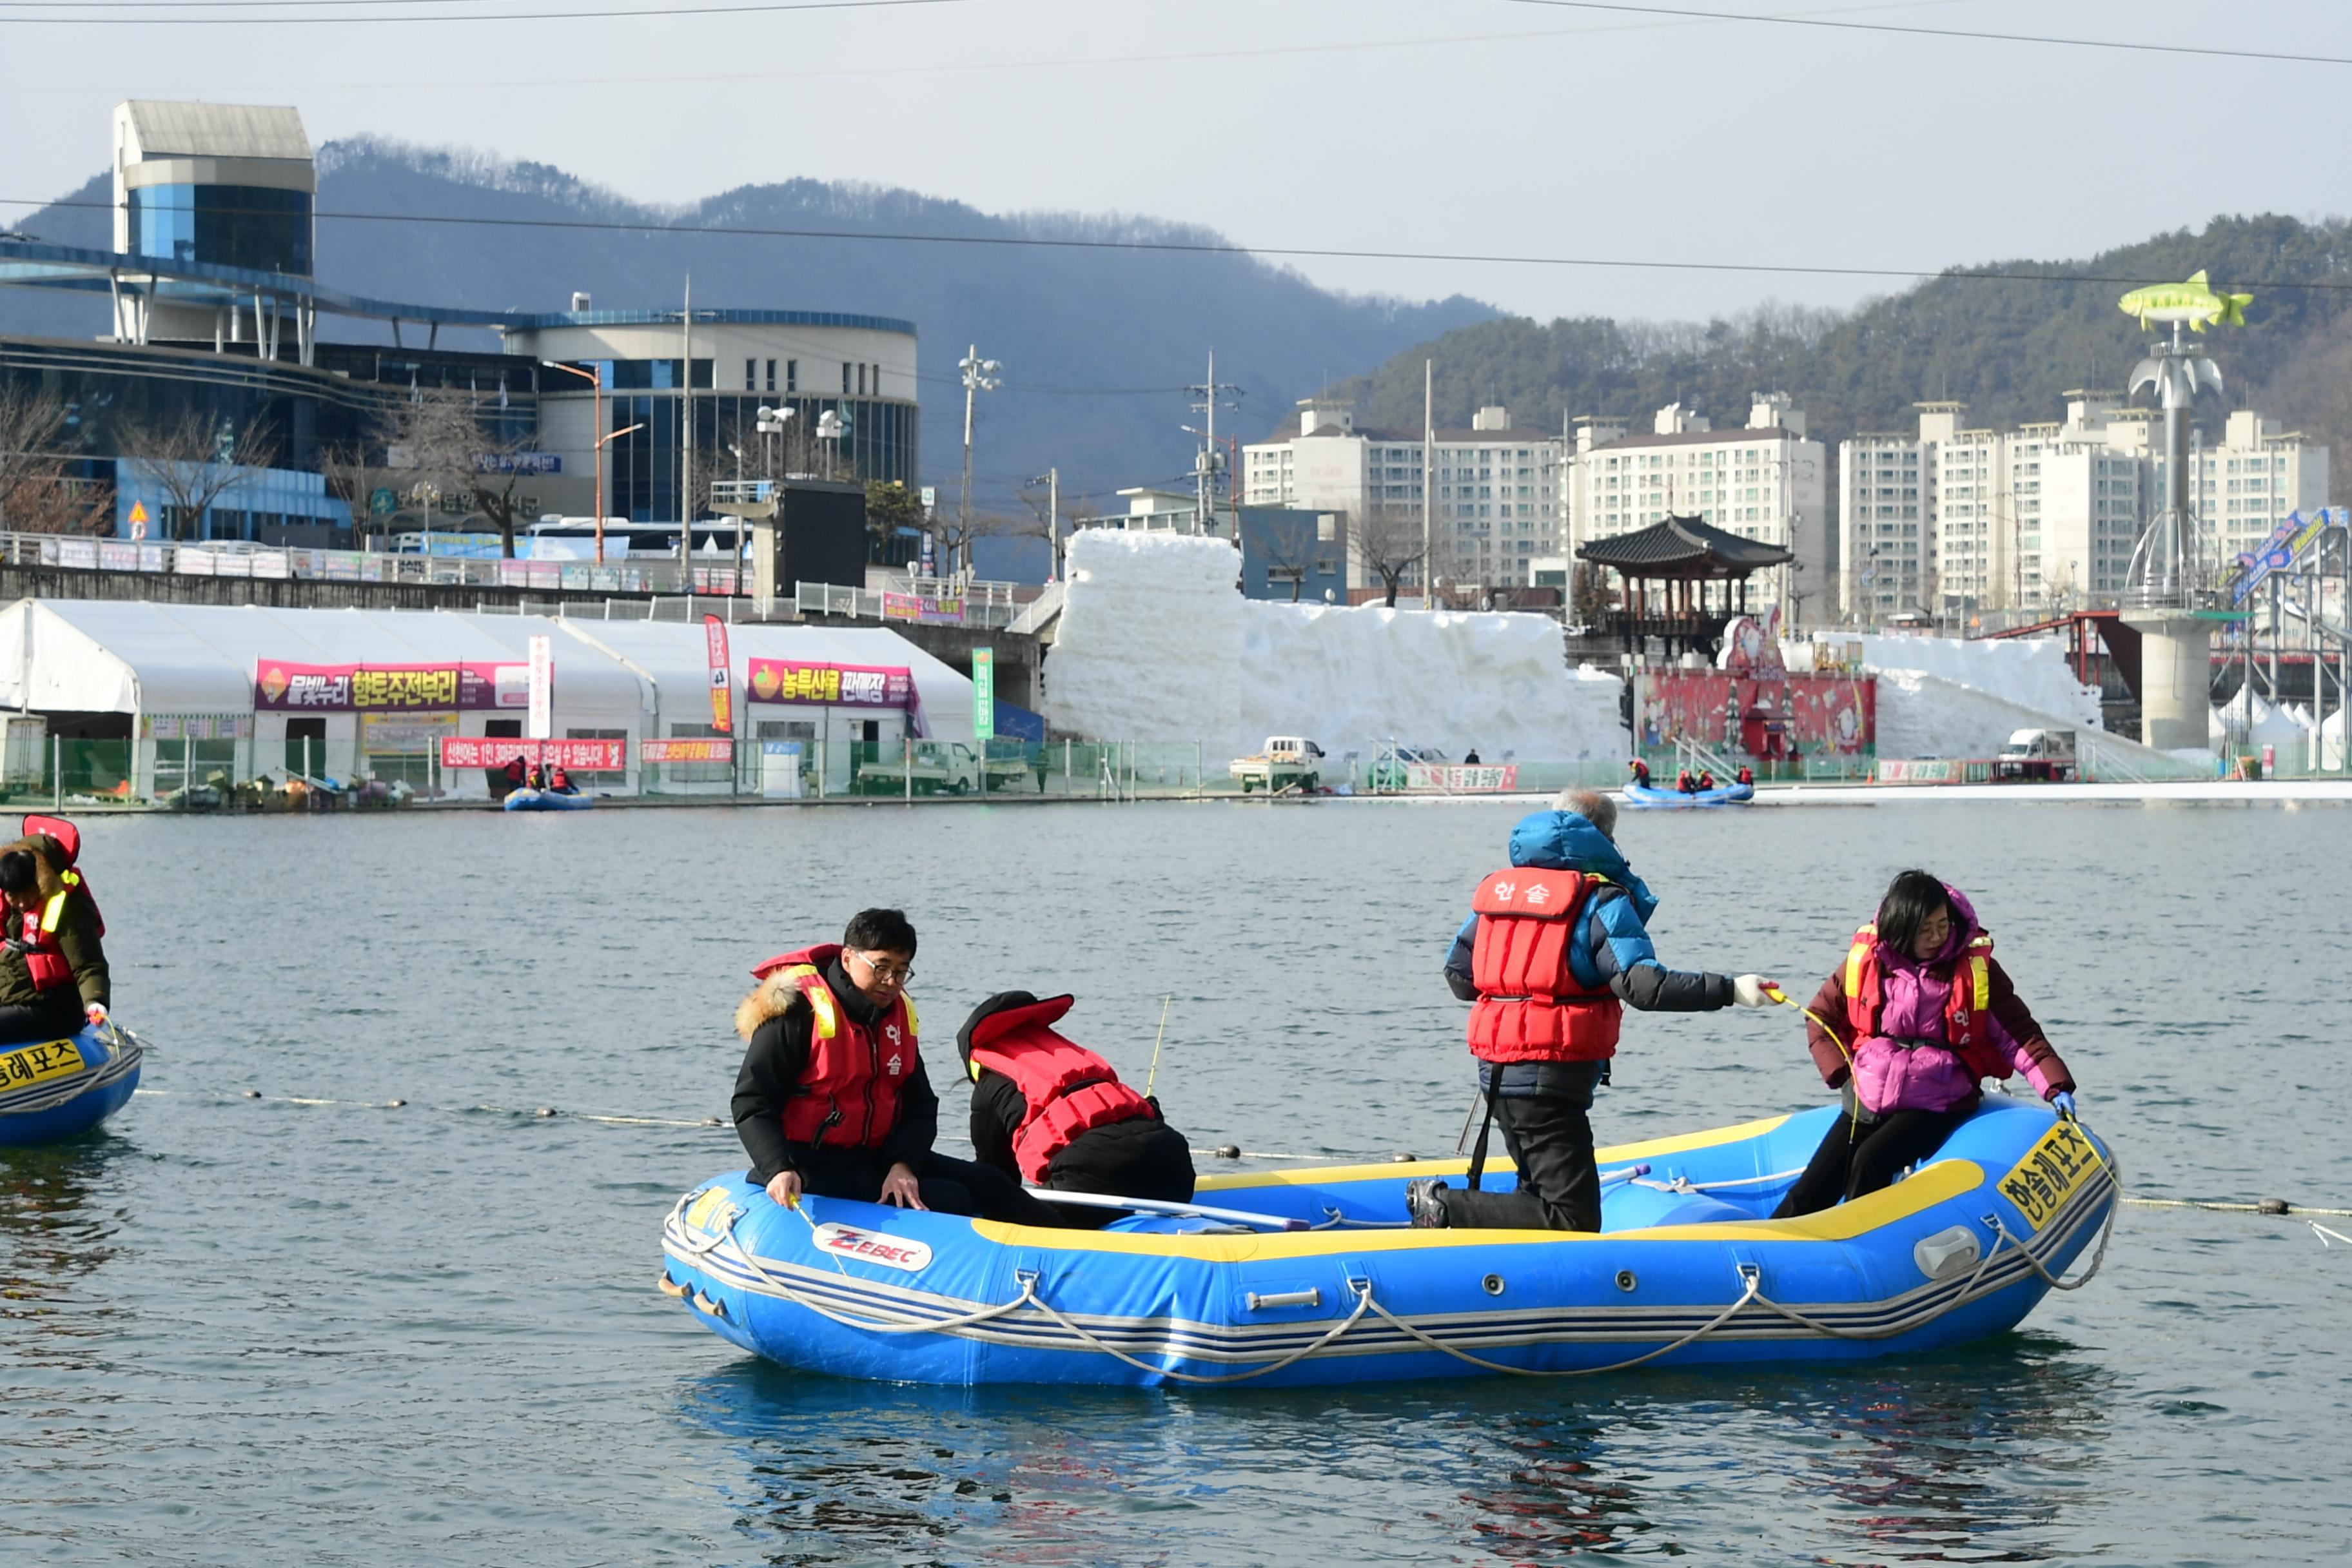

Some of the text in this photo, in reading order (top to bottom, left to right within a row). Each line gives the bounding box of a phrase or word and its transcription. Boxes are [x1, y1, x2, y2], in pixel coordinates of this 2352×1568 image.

[288, 674, 349, 705] 물빛누리
[353, 670, 456, 707] 향토주전부리
[782, 667, 839, 701] 농특산물
[841, 671, 886, 703] 판매장
[447, 742, 478, 765] 산천어는
[481, 743, 495, 765] 1인
[563, 745, 571, 766] 수
[1494, 881, 1549, 905] 한솔
[885, 1024, 901, 1075] 한솔
[2004, 1128, 2094, 1222] 한솔레포츠
[827, 1229, 917, 1263] ZEBEC
